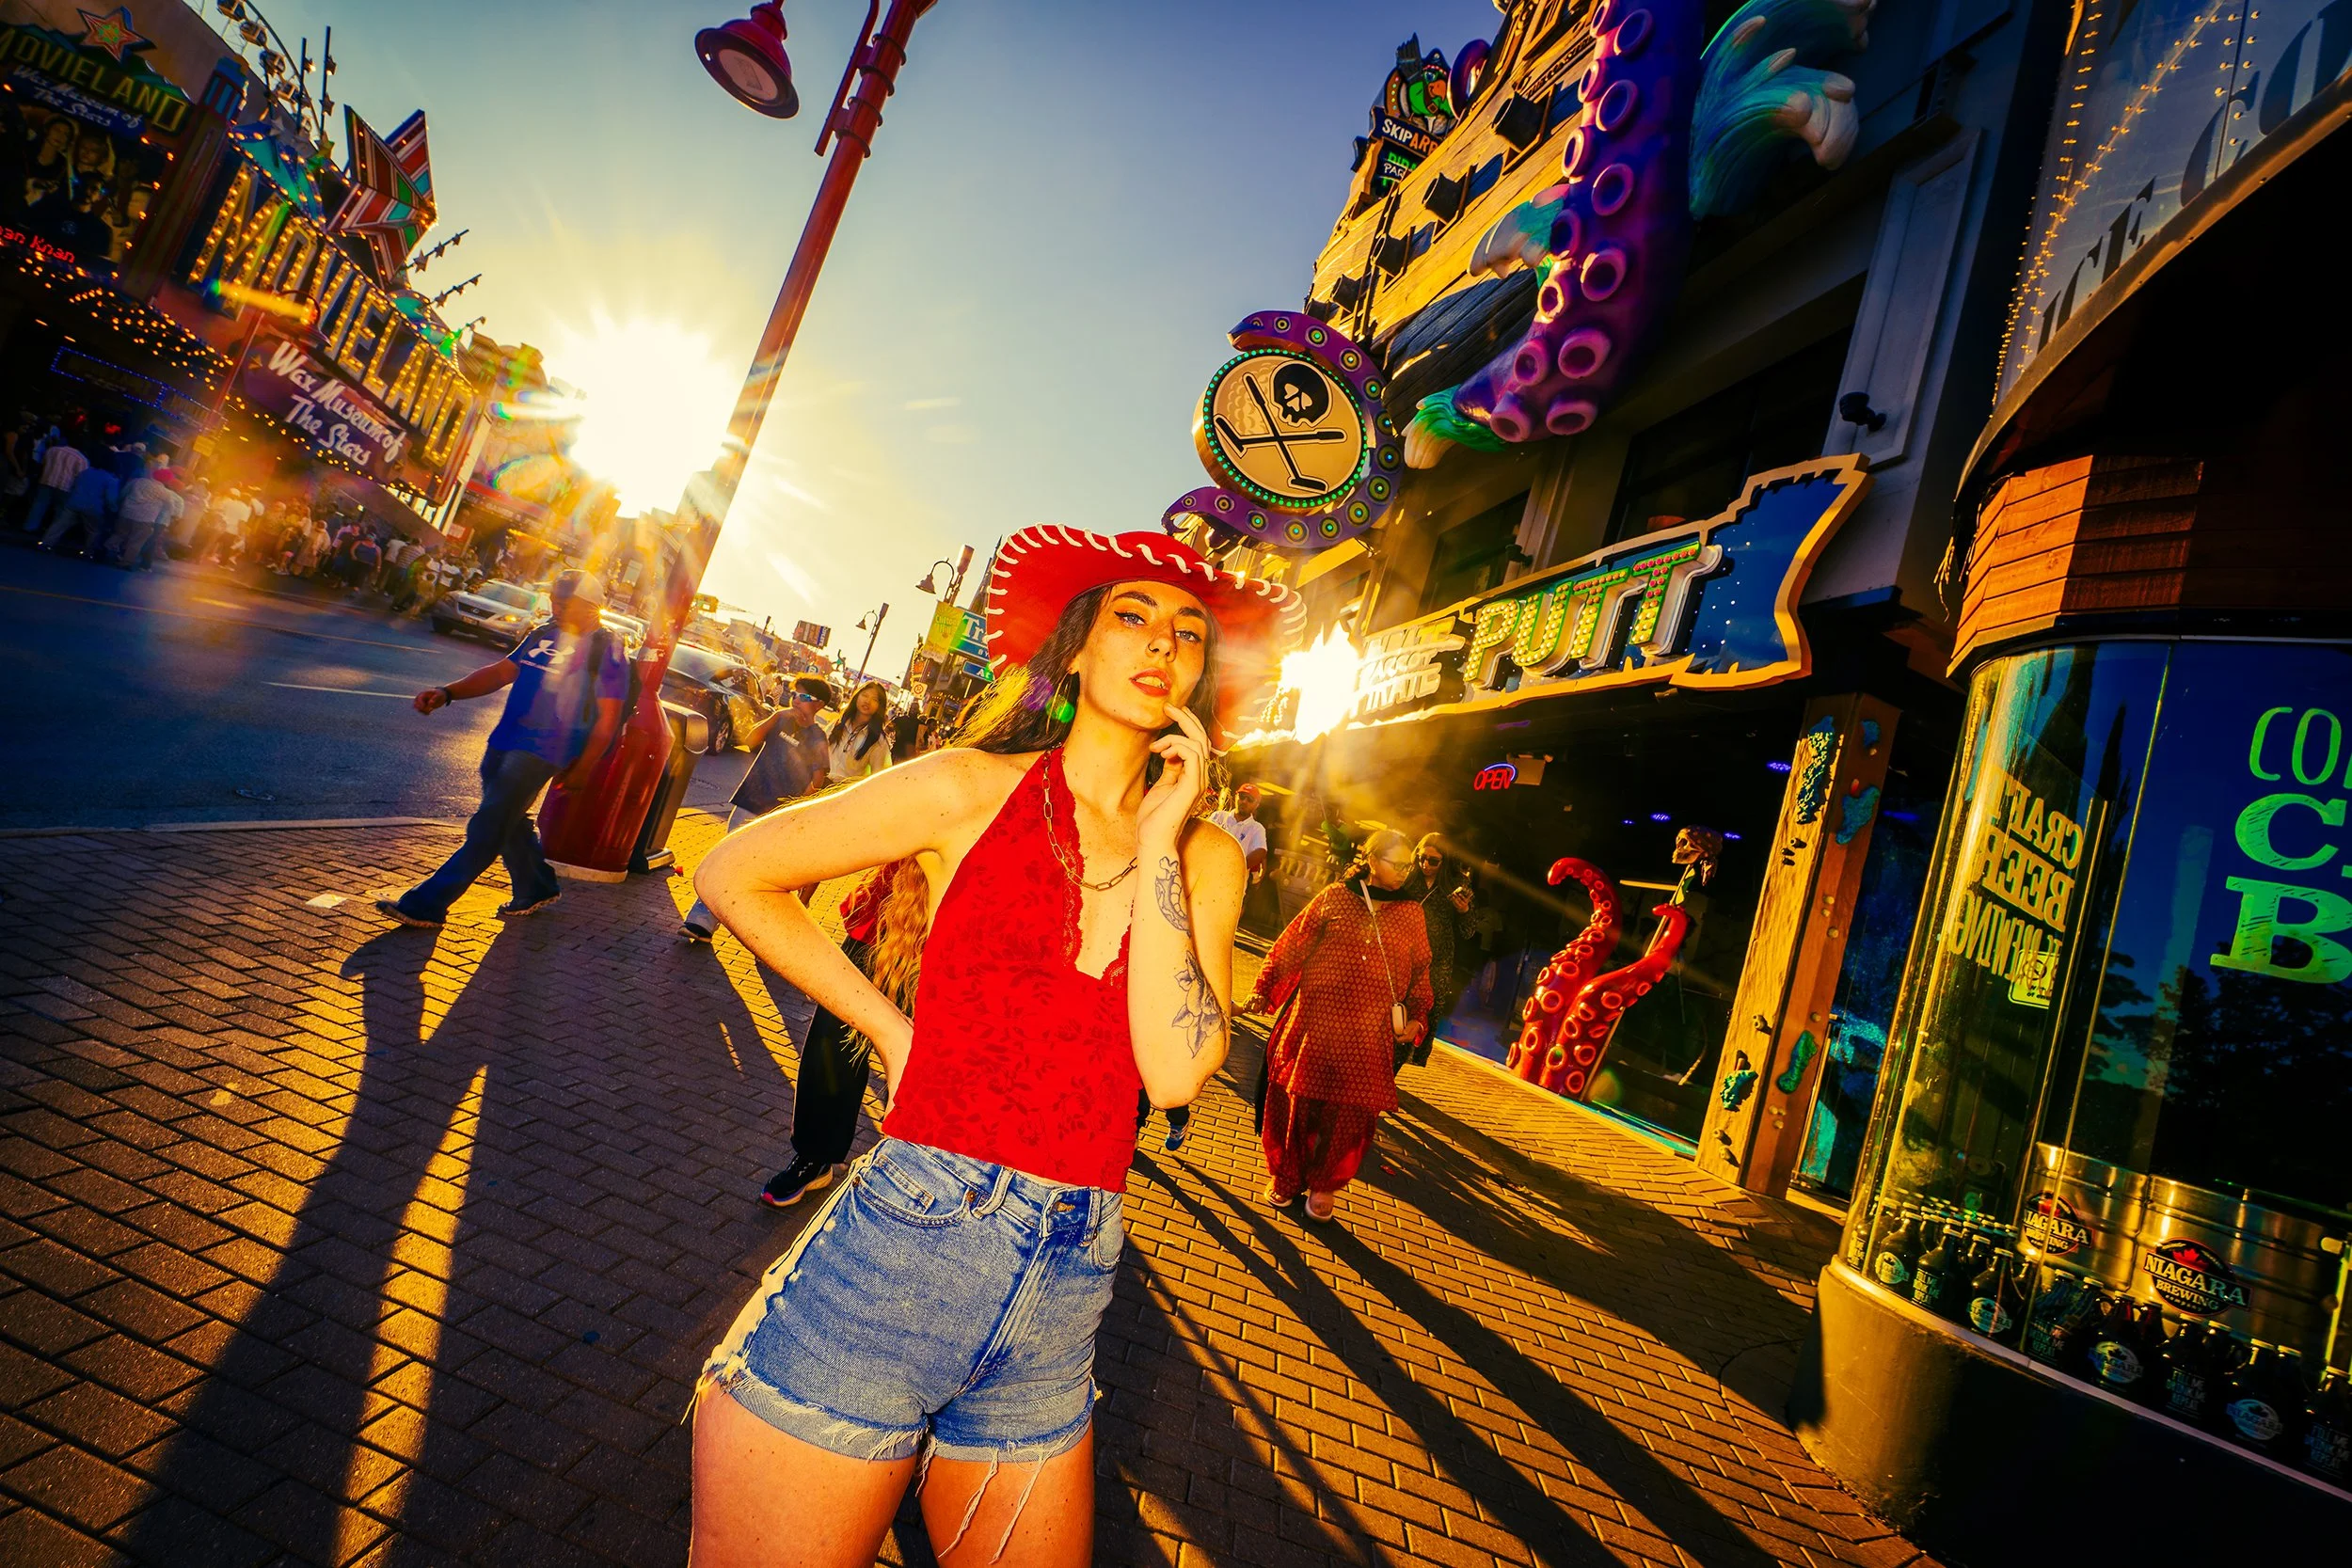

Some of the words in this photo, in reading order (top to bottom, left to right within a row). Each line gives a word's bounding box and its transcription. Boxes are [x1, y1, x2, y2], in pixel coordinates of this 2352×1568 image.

[189, 160, 478, 467] MOVIELAND
[268, 341, 318, 393] Wax
[310, 378, 384, 443] Museum
[381, 431, 407, 464] of
[284, 393, 323, 436] The
[316, 422, 373, 467] Stars
[1464, 541, 1710, 685] PUTT
[1473, 768, 1513, 790] OPEN
[2249, 707, 2352, 789] CO
[2145, 1254, 2247, 1307] NIAGARA
[2155, 1278, 2219, 1311] BREWING
